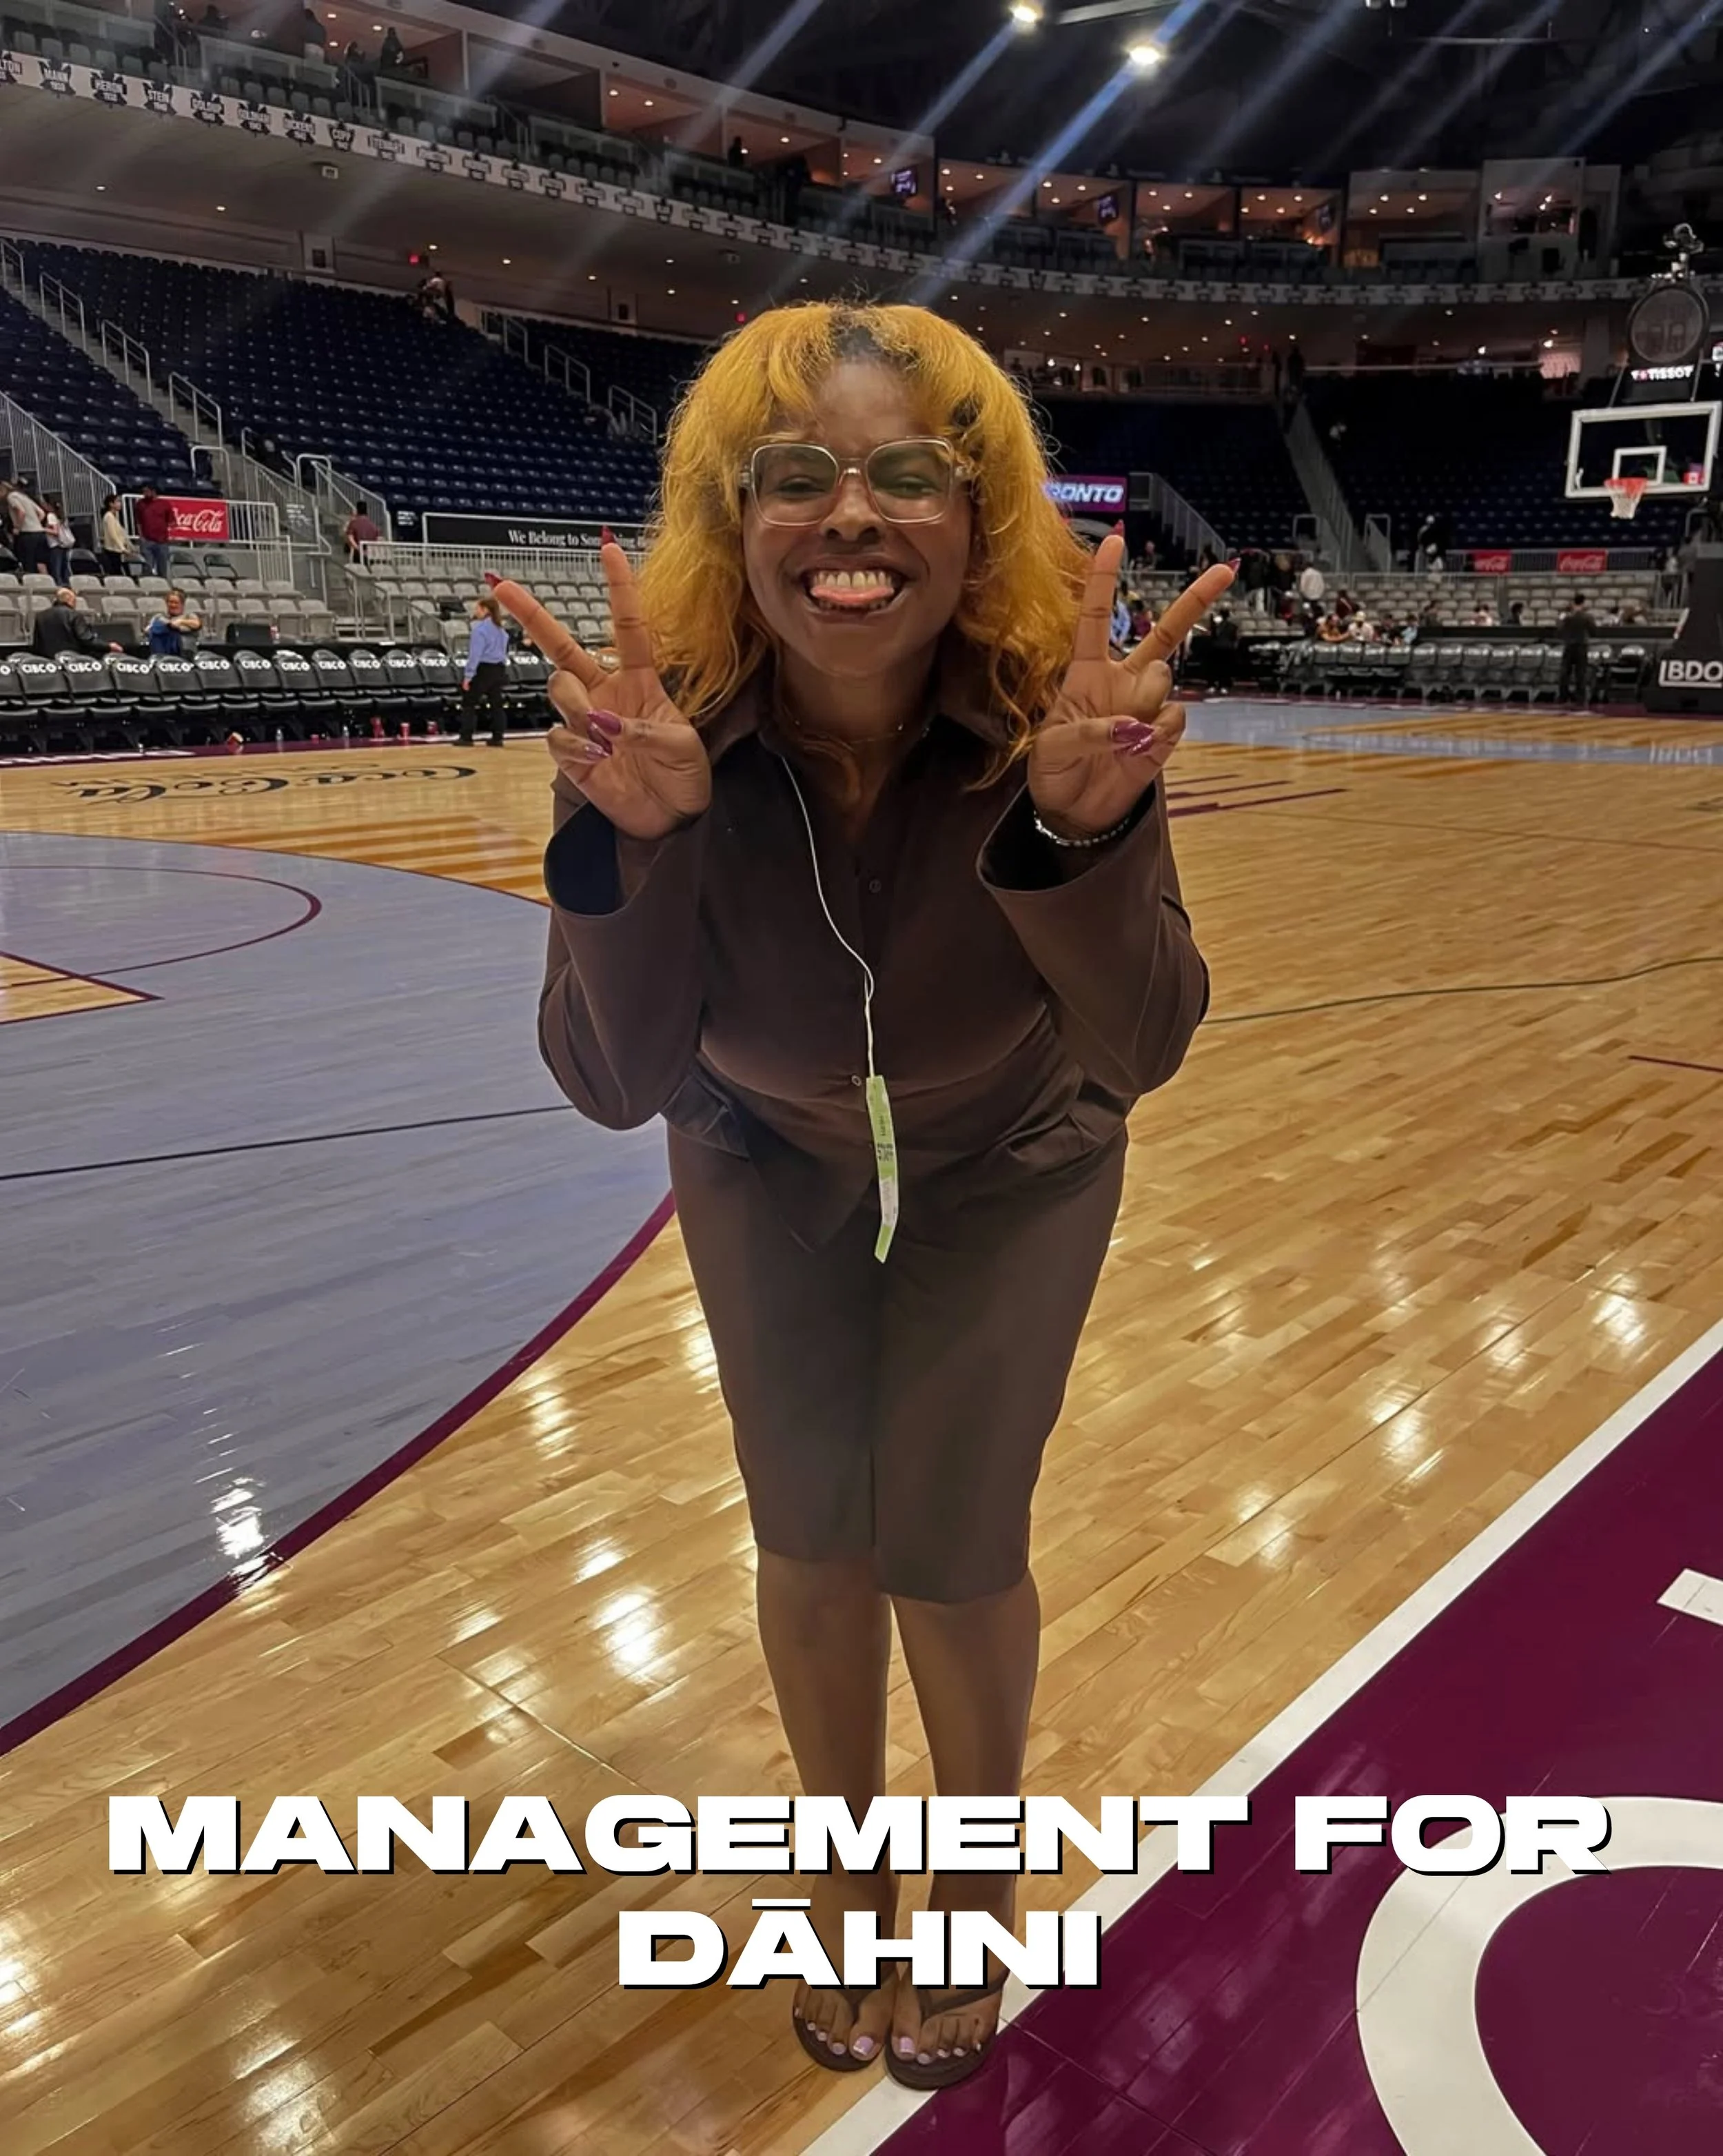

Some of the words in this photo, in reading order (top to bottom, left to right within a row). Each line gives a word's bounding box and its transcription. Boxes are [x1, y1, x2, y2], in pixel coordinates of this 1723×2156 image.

[1647, 365, 1694, 380] TISSOT
[1047, 482, 1124, 502] RONTO
[509, 529, 527, 544] We
[528, 530, 566, 547] Belong
[567, 533, 579, 546] to
